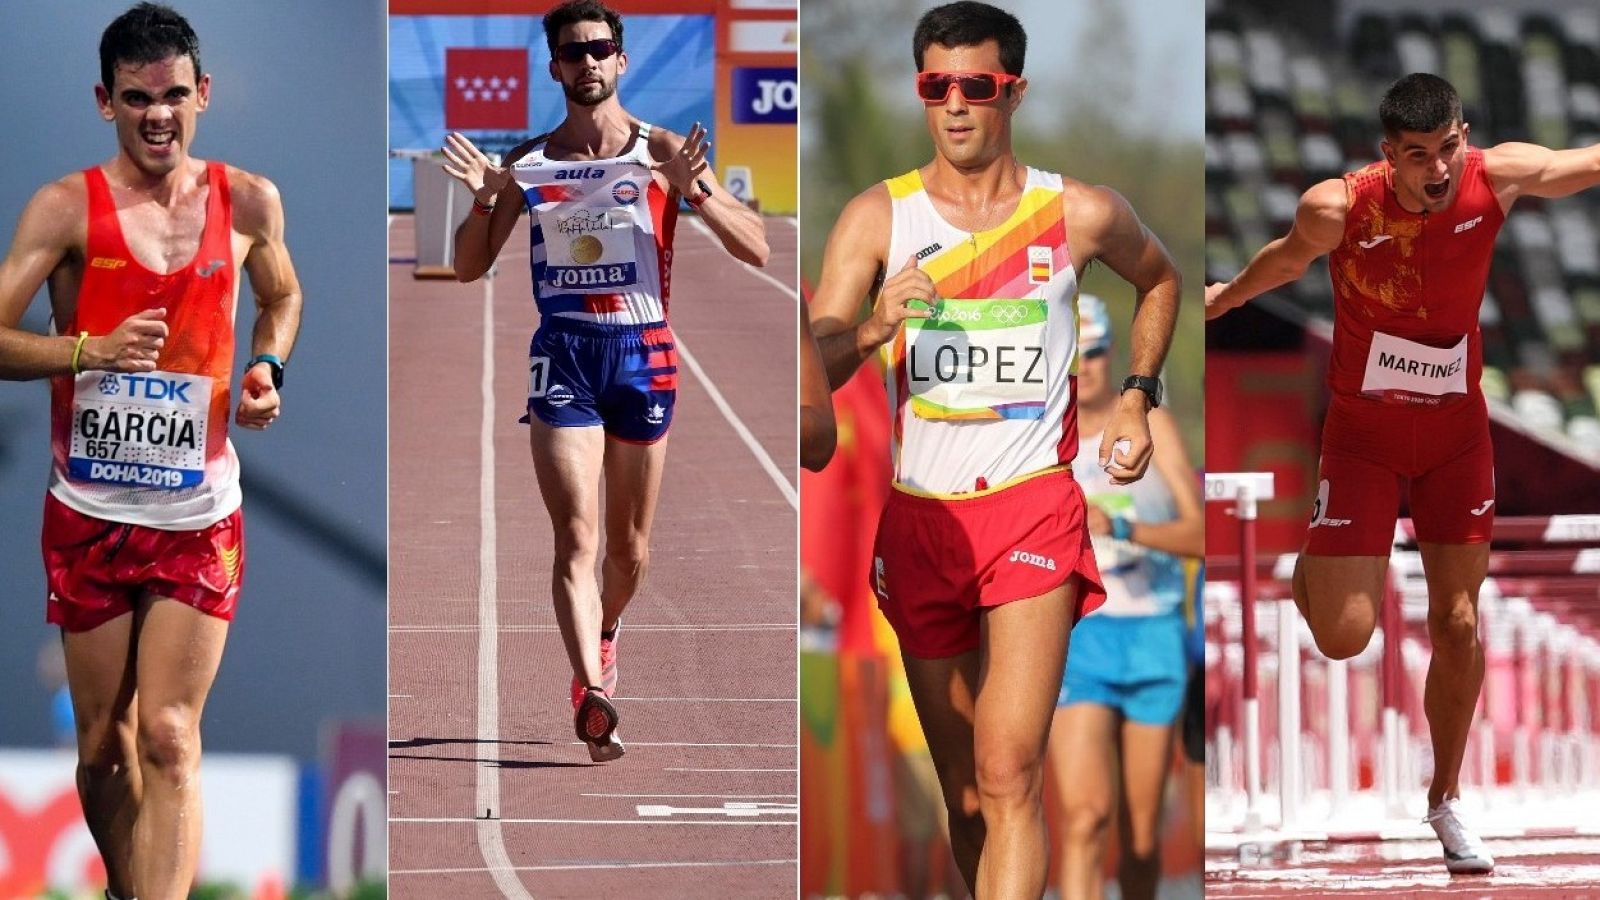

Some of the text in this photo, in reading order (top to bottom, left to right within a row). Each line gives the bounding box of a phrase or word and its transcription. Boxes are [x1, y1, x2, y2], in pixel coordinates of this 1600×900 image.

[752, 80, 797, 114] JO
[554, 167, 605, 179] aula
[1454, 215, 1483, 234] ESP
[91, 257, 128, 269] ESP
[915, 243, 942, 260] oma
[530, 362, 544, 391] 1
[910, 345, 1044, 383] LOPEZ
[1378, 352, 1462, 378] MARTINEZ
[121, 375, 192, 403] TDK
[81, 409, 195, 449] GARCÍA
[86, 440, 120, 459] 657
